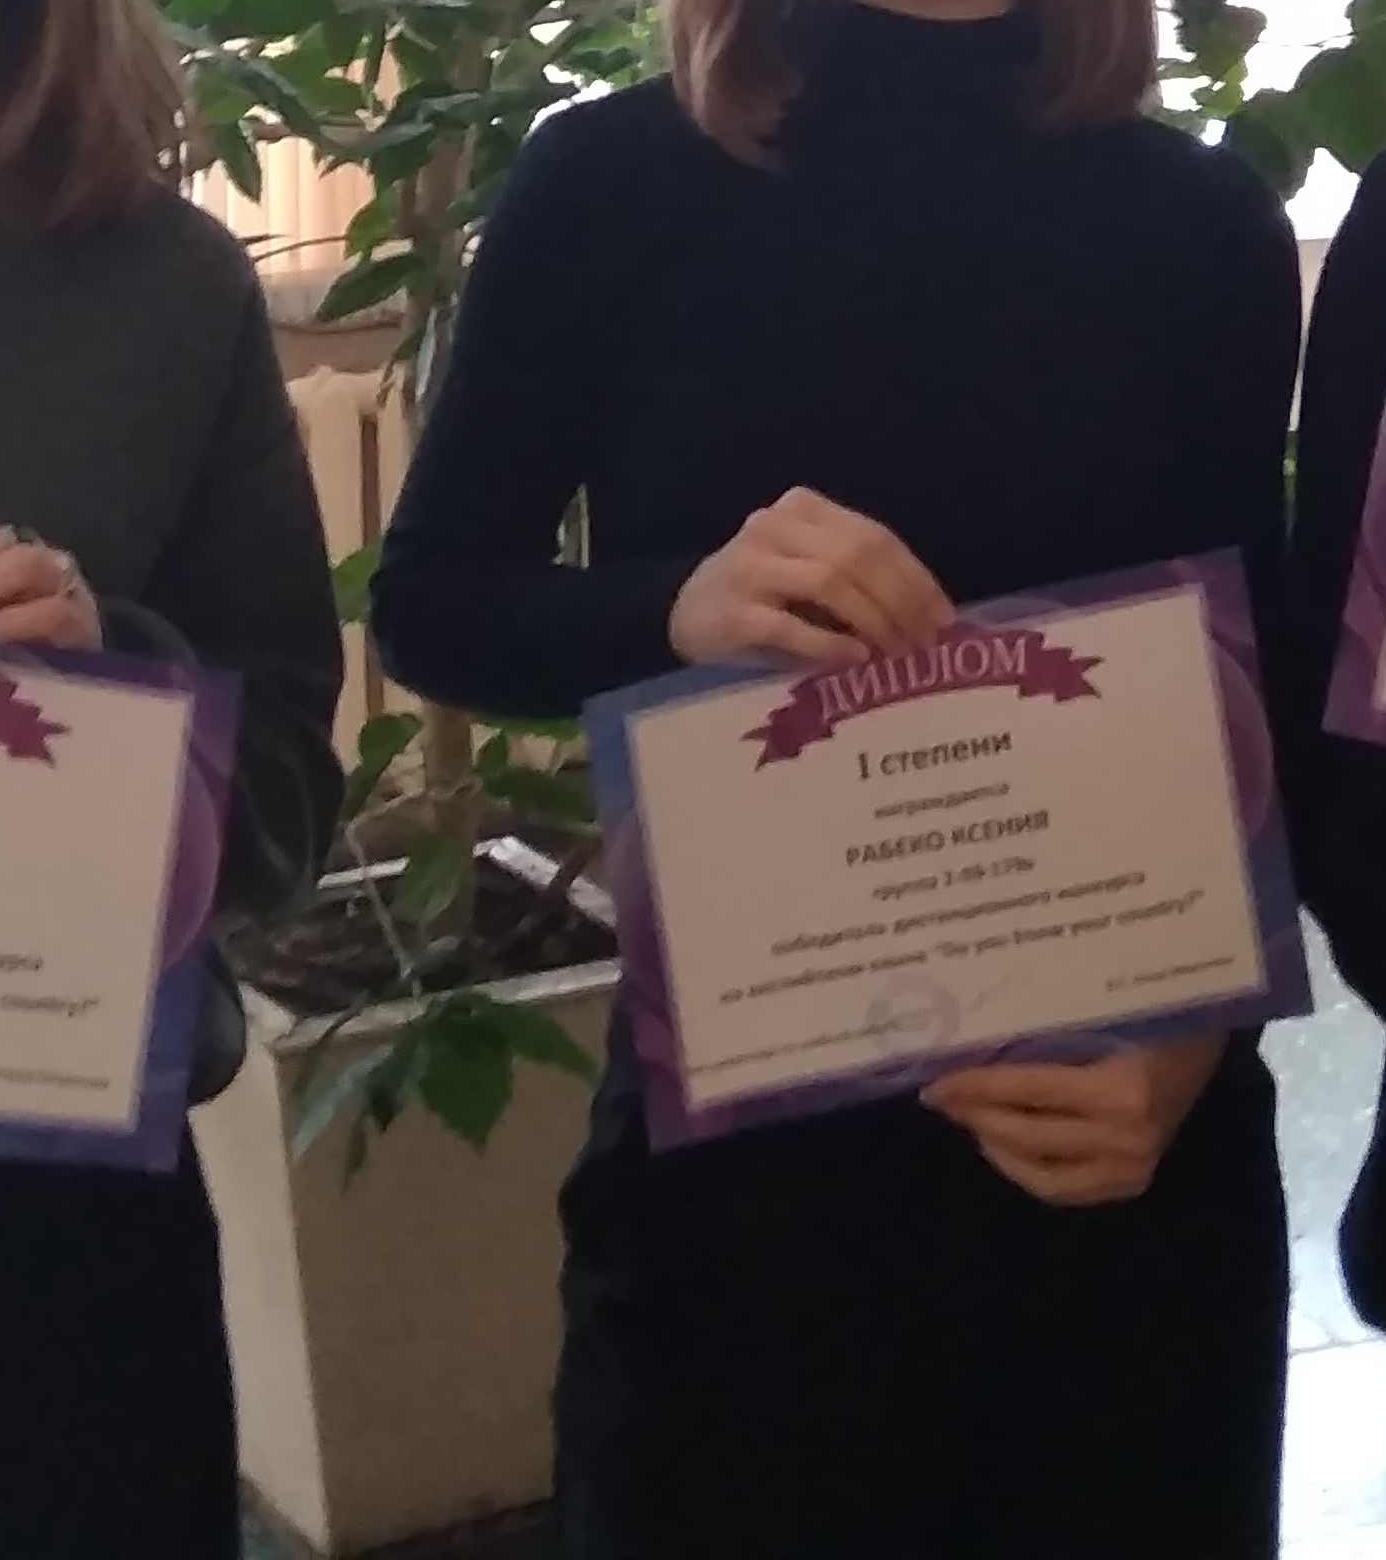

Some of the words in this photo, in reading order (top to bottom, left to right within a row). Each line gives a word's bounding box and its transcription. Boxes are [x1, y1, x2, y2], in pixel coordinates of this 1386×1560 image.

[817, 637, 1026, 723] ДИПЛОМ
[857, 752, 870, 781] I
[879, 732, 1012, 776] степени
[951, 809, 1049, 848] КСЕНИЯ
